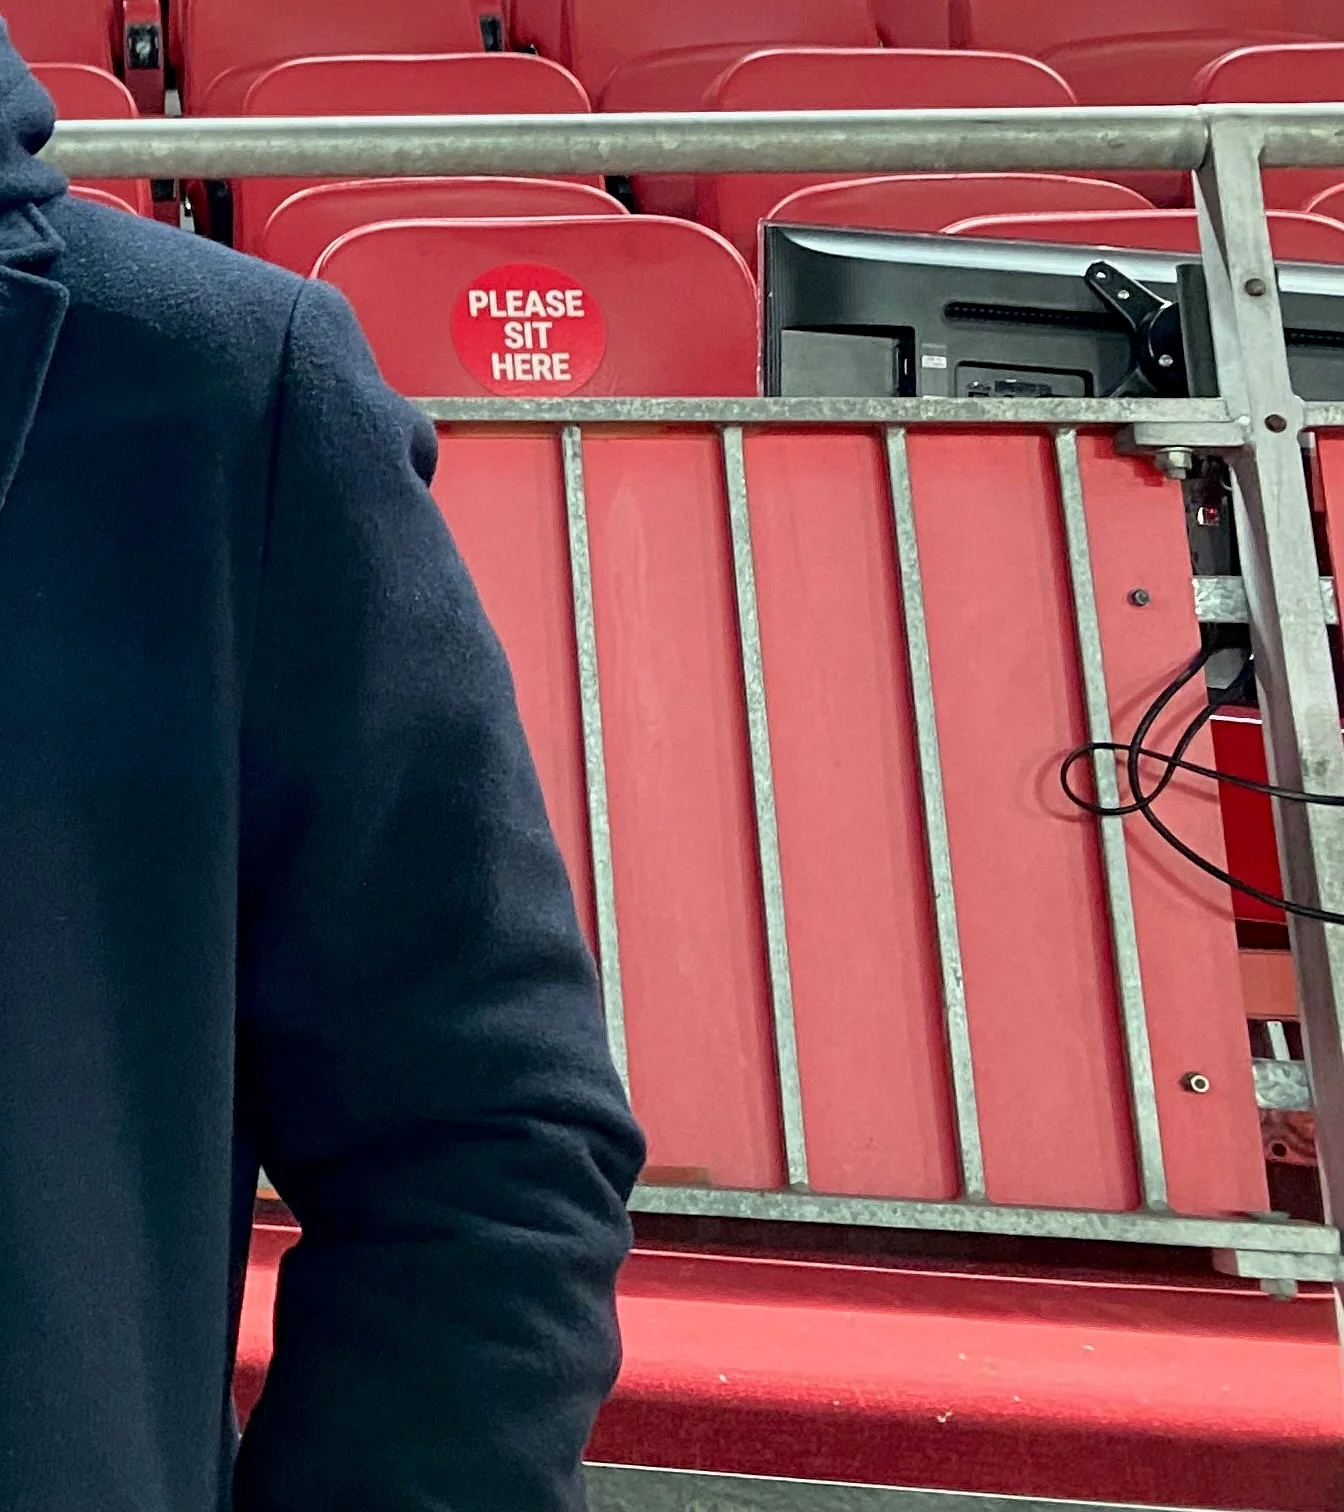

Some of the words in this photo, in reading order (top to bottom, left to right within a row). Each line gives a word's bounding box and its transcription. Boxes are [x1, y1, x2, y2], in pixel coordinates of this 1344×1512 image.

[468, 289, 585, 318] PLEASE
[504, 321, 553, 349] SIT
[491, 352, 572, 381] HERE
